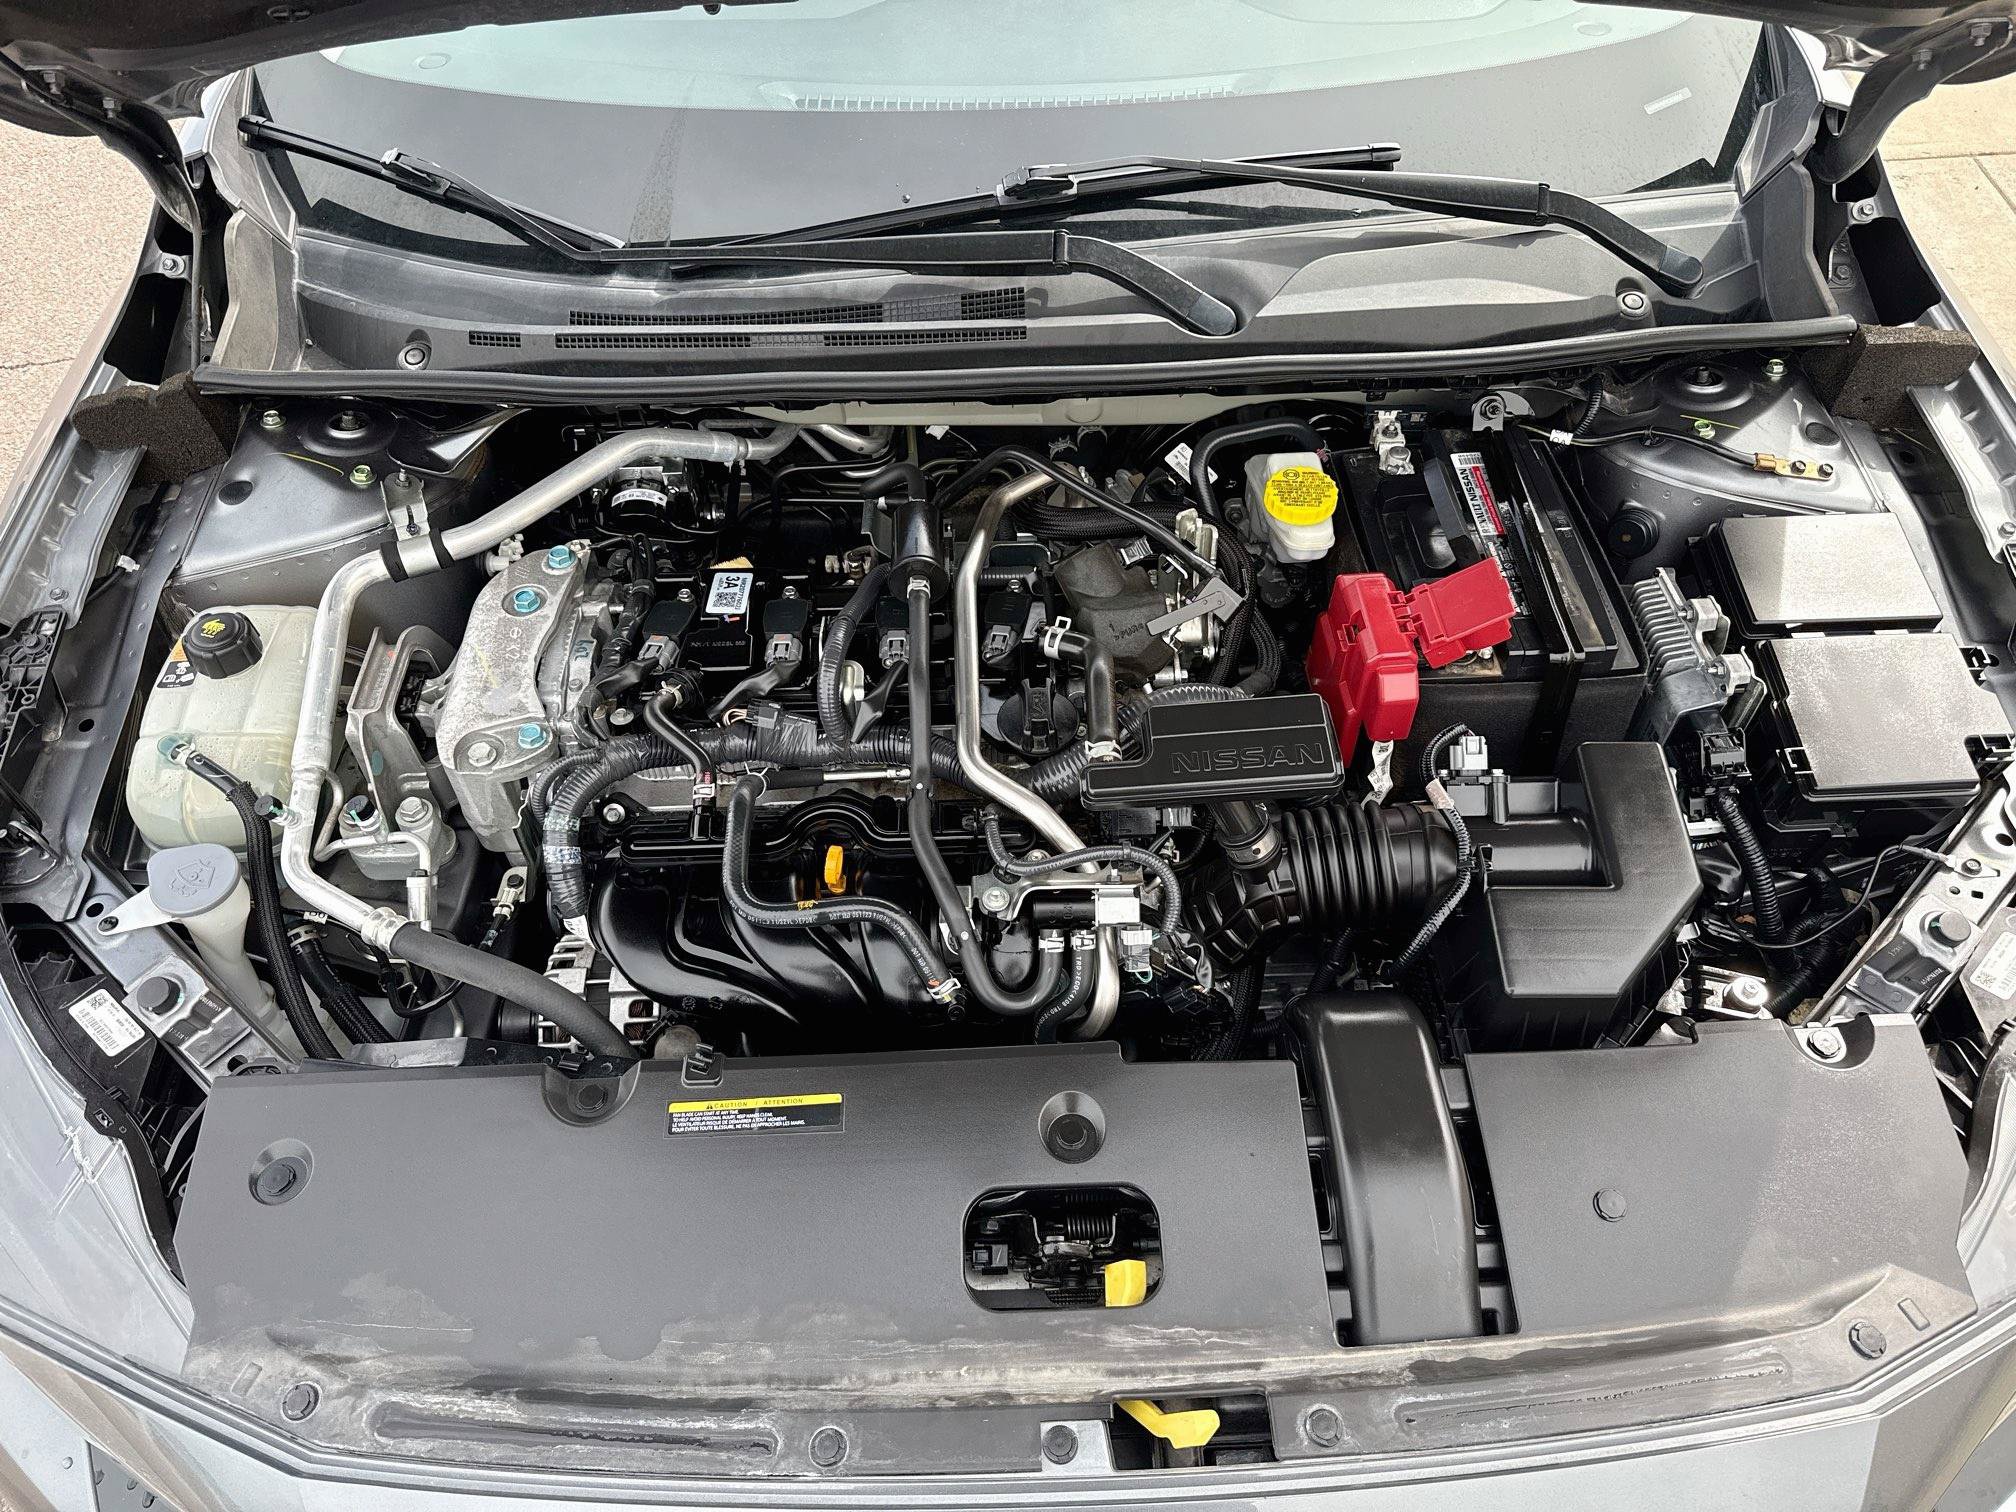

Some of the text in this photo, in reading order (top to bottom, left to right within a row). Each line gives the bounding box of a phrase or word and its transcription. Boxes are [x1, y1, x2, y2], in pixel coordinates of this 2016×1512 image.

[1459, 468, 1479, 503] NISSAN
[724, 576, 740, 589] 3A
[1170, 743, 1325, 774] NISSAN
